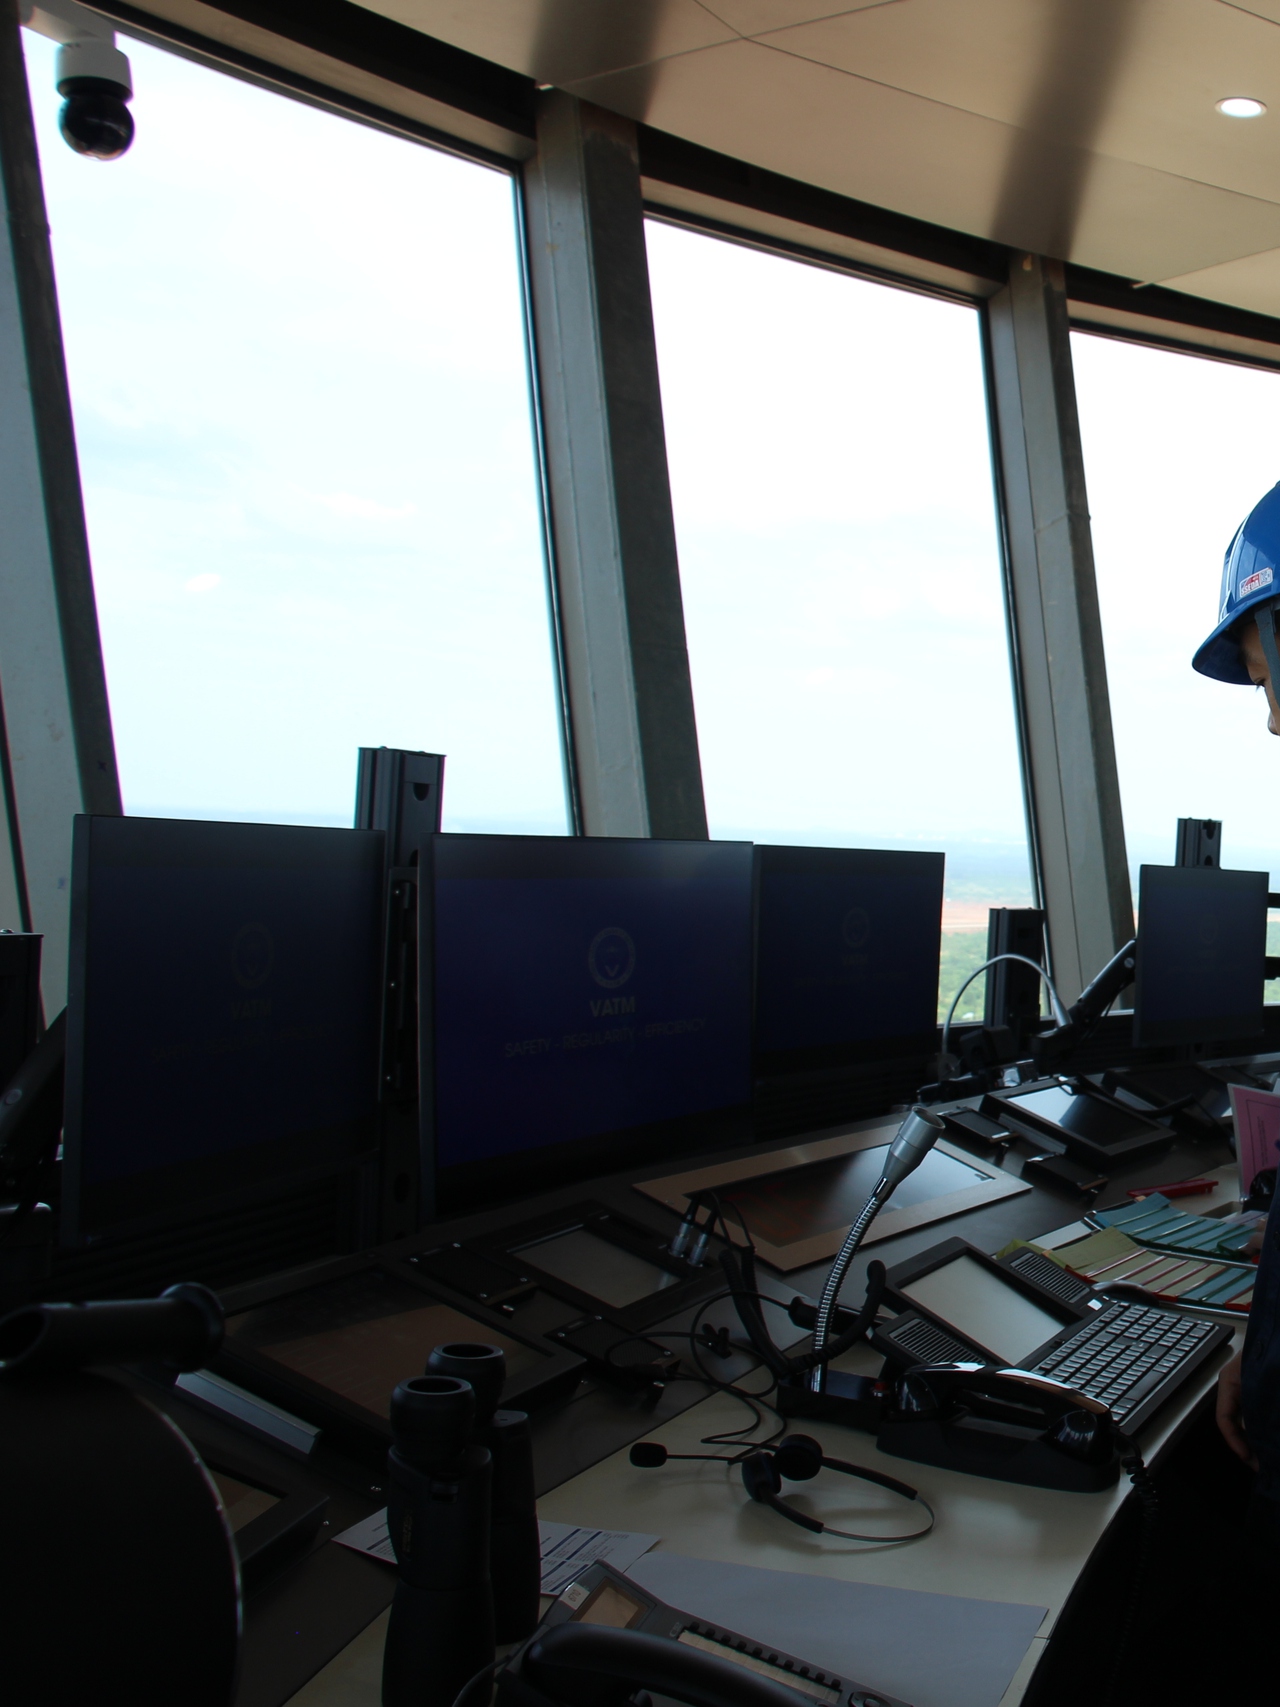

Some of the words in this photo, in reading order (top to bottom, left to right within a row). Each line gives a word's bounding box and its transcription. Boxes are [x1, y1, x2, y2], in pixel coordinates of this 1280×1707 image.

[231, 997, 272, 1020] VATM
[590, 996, 635, 1017] VATM
[505, 1038, 552, 1058] SAFETY
[562, 1027, 636, 1050] REGULARITY
[644, 1017, 707, 1039] EFFICIENCY
